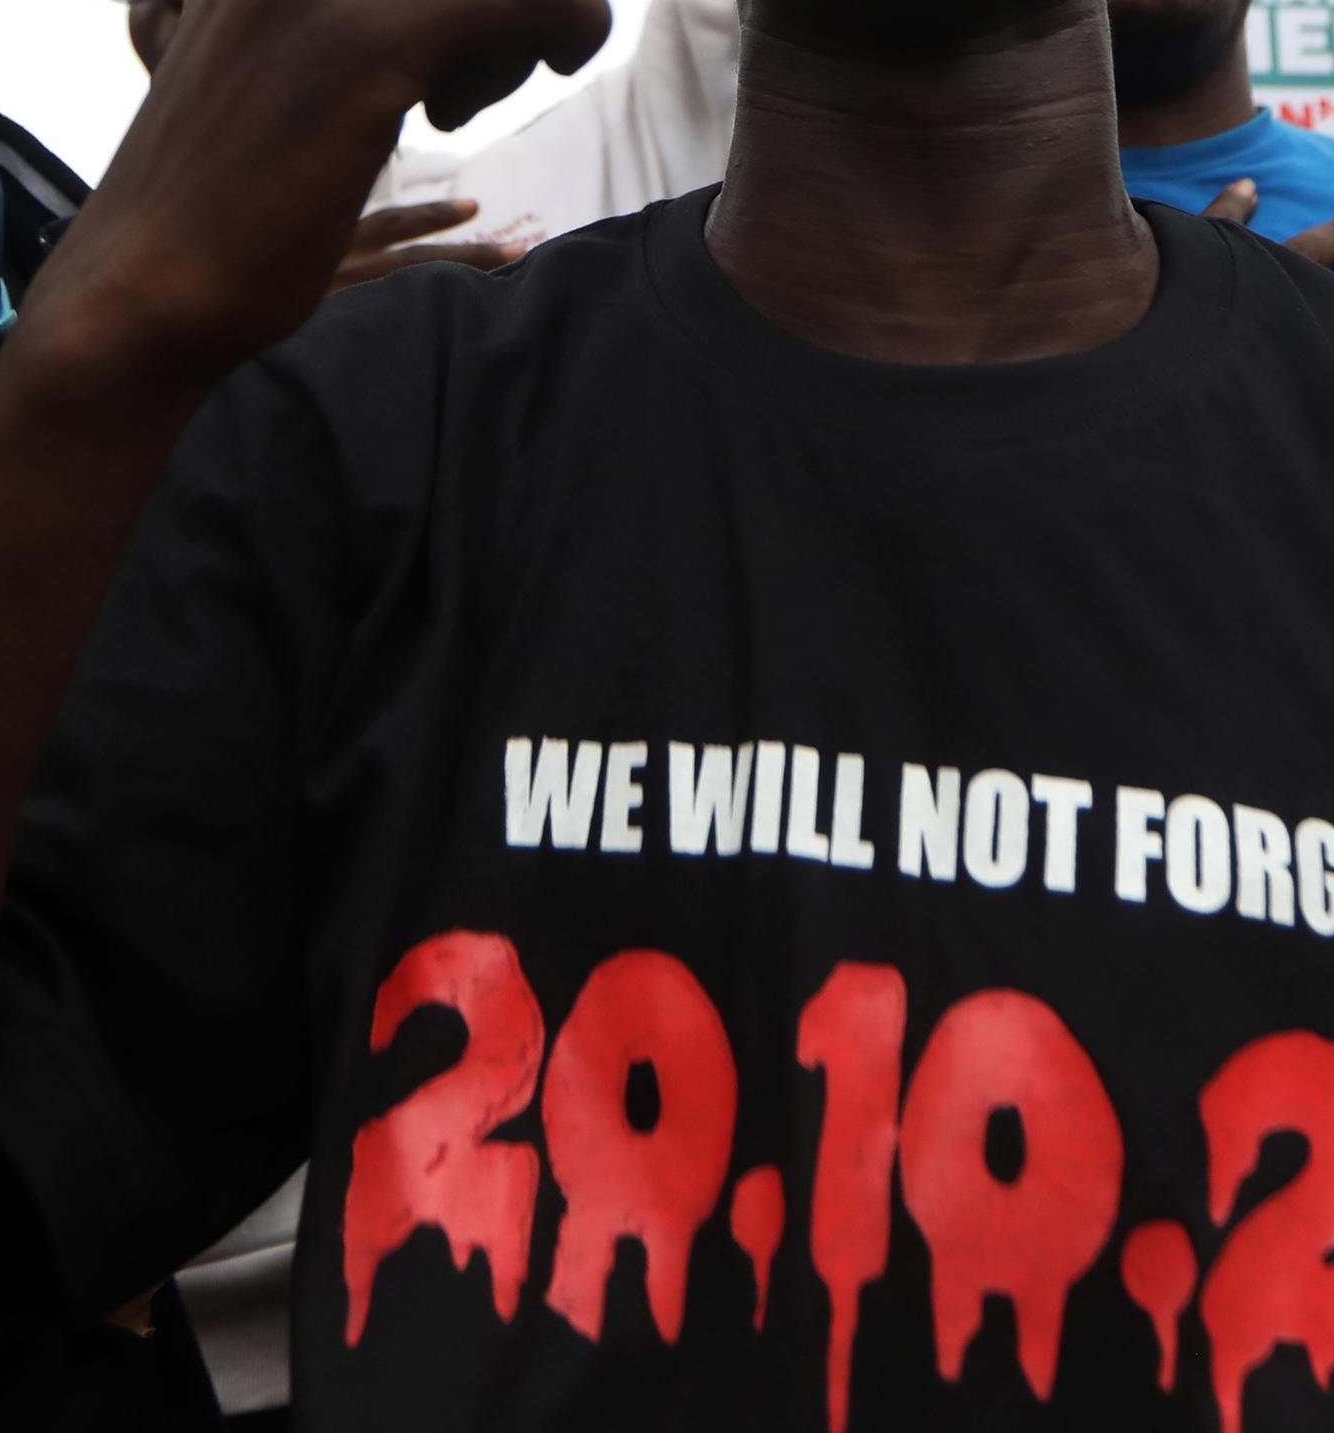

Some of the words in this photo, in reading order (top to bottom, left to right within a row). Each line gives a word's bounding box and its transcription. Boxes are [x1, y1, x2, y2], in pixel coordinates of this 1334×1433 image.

[504, 735, 648, 854] WE
[668, 739, 875, 869] WILL
[897, 762, 1093, 894] NOT
